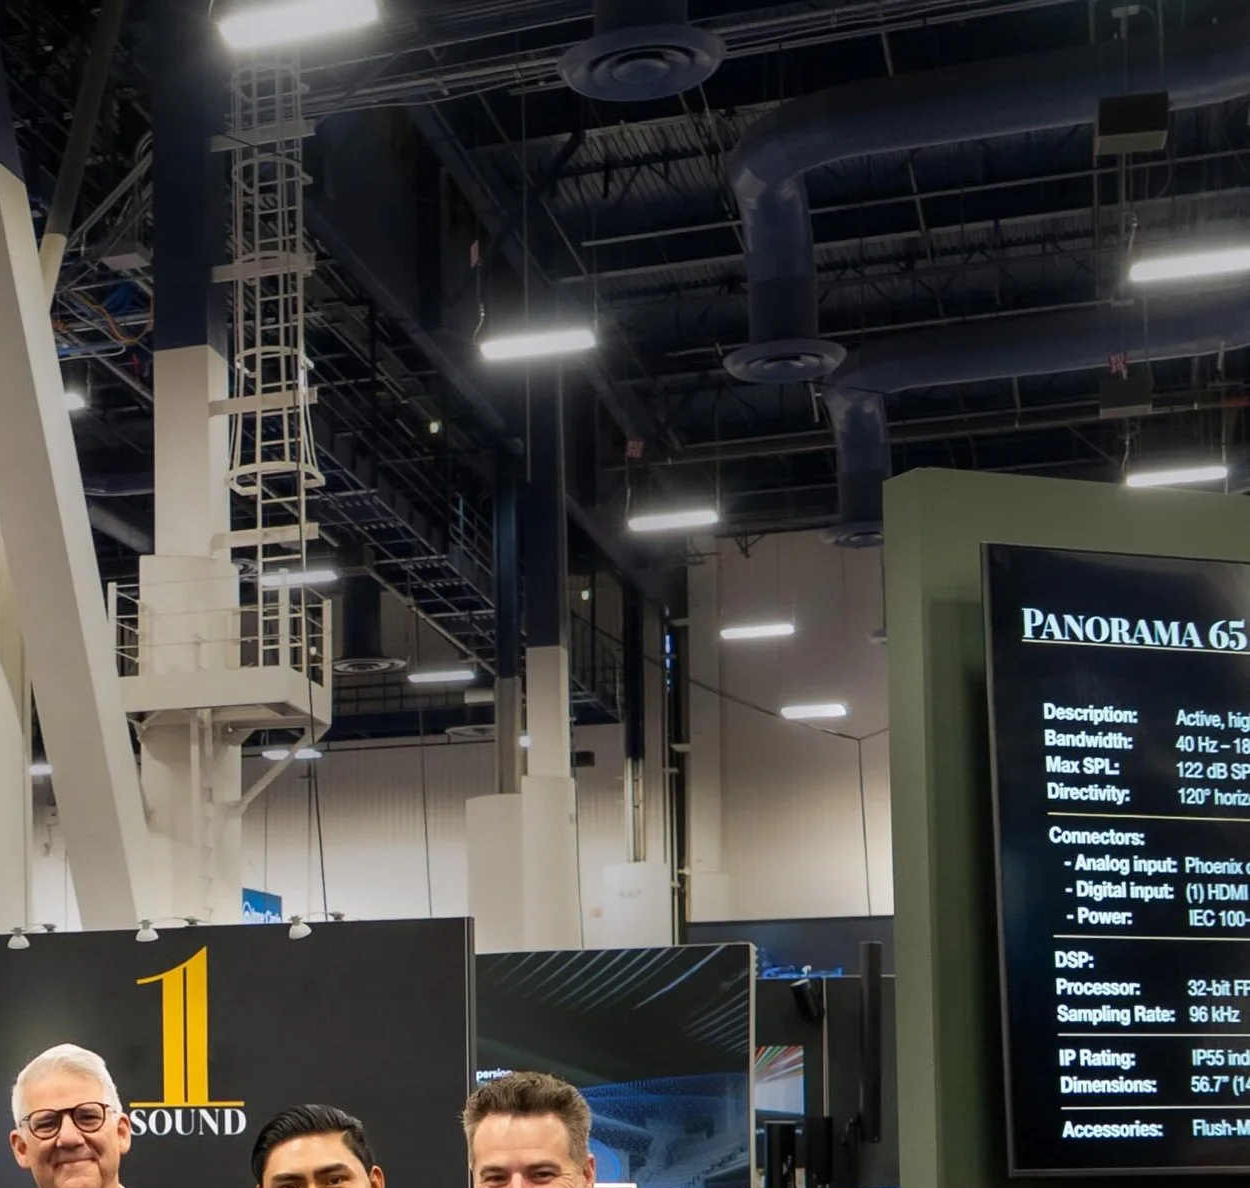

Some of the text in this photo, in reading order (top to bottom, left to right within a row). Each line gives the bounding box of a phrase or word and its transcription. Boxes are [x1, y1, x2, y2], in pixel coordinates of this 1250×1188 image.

[1021, 608, 1248, 651] PANORAMA 65
[1043, 703, 1138, 725] Description:
[1176, 709, 1225, 730] Active,
[1044, 729, 1133, 749] Bandwidth:
[1176, 735, 1195, 752] 40
[1198, 736, 1218, 753] Hz
[1046, 756, 1080, 774] Max
[1083, 757, 1120, 775] SPL:
[1176, 761, 1204, 778] 122
[1206, 763, 1228, 779] dB
[1047, 782, 1130, 805] Directivity:
[1049, 826, 1145, 845] Connectors:
[1075, 854, 1130, 875] Analog
[1133, 855, 1178, 876] input:
[1185, 857, 1243, 874] Phoenix
[1076, 880, 1127, 901] Digital
[1130, 882, 1174, 902] input:
[1186, 883, 1204, 903] (1)
[1208, 884, 1249, 900] HDMI
[1078, 907, 1133, 925] Power:
[1189, 909, 1216, 926] IEC
[1055, 951, 1094, 968] DSP:
[1056, 978, 1141, 996] Processor:
[1188, 980, 1231, 996] 32-bit
[1057, 1004, 1240, 1026] Sampling Rate: 96 kHz
[1059, 1049, 1076, 1066] IP
[1079, 1049, 1136, 1070] Rating:
[1192, 1049, 1225, 1066] IP55
[1060, 1076, 1157, 1093] Dimensions:
[130, 1108, 247, 1136] SOUND
[1062, 1120, 1163, 1138] Accessories:
